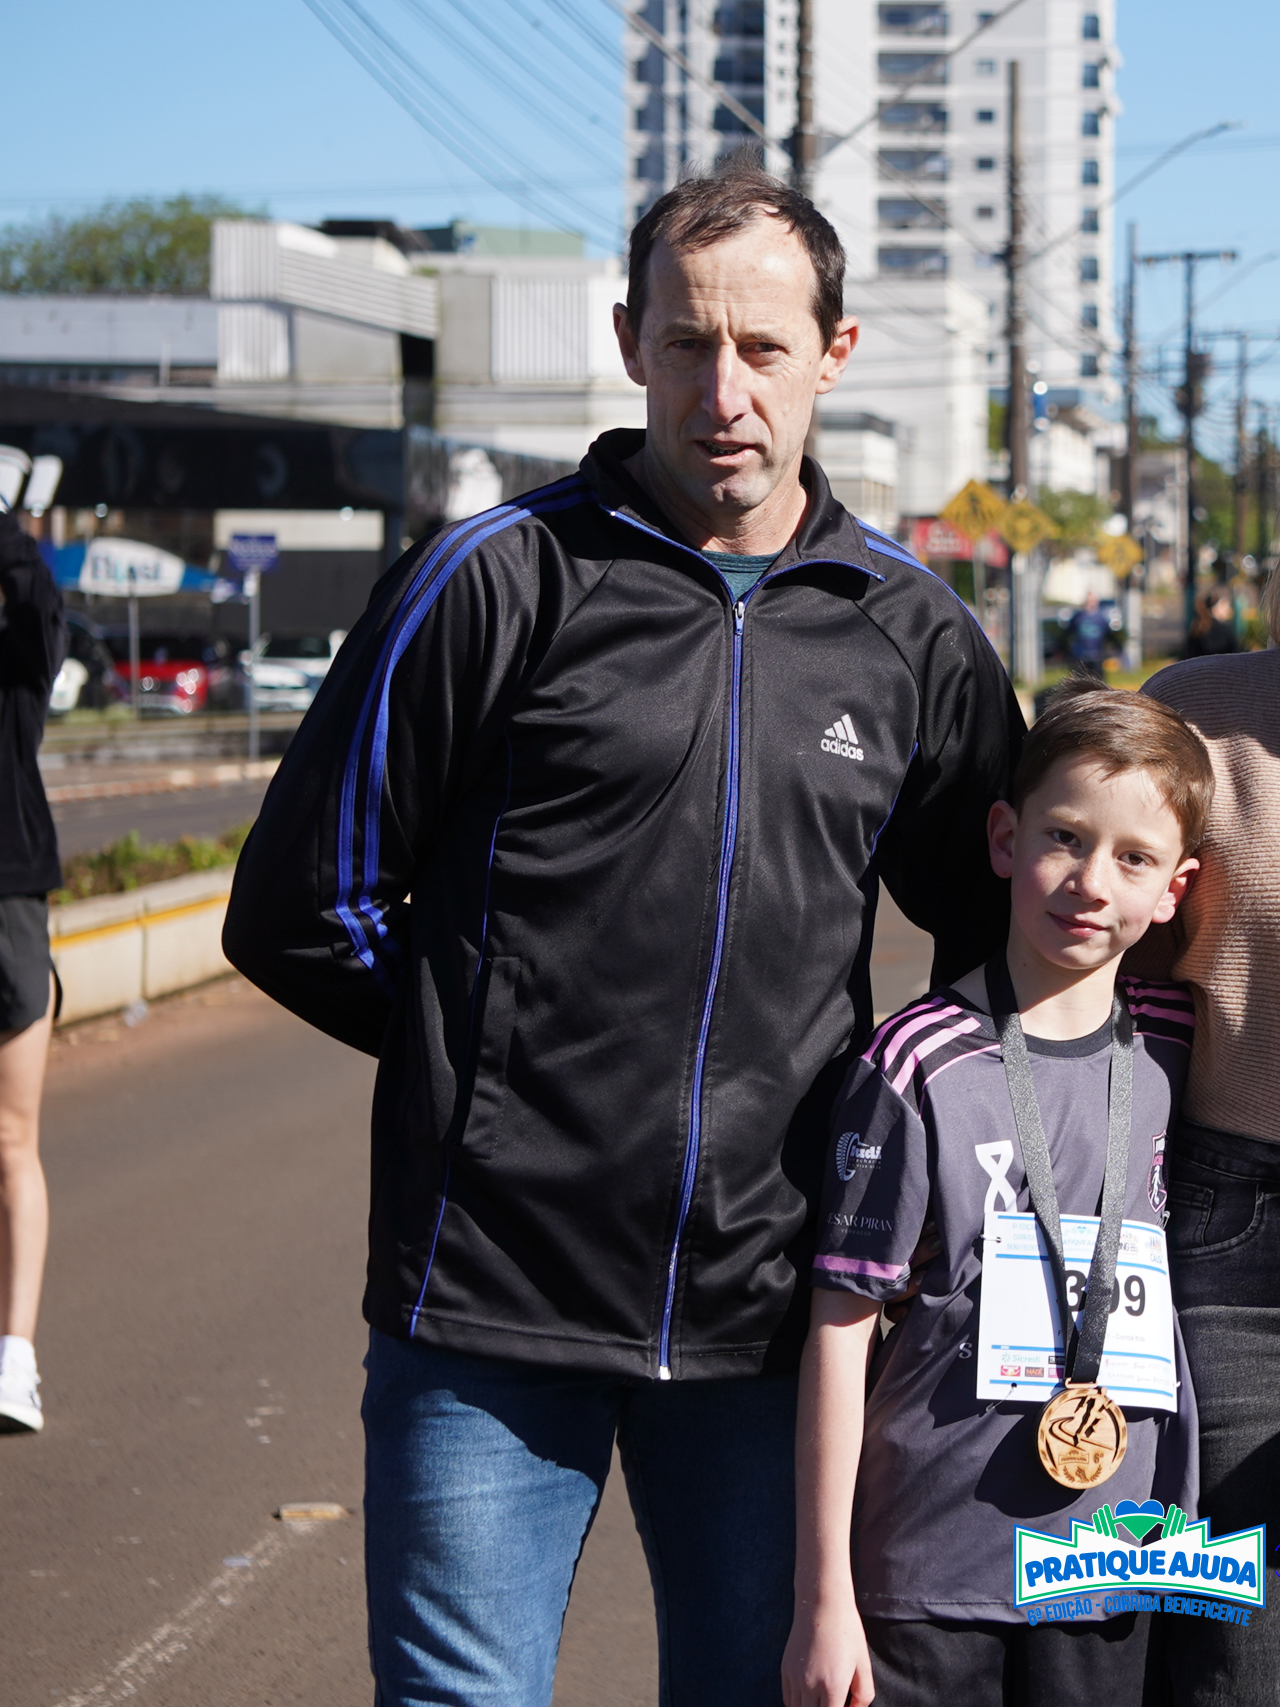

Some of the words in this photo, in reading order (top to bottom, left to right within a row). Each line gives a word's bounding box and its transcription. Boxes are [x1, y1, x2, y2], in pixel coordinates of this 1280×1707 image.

[821, 738, 864, 761] adidas
[1115, 1333, 1134, 1341] Corrida
[1012, 1354, 1041, 1363] Sicredi
